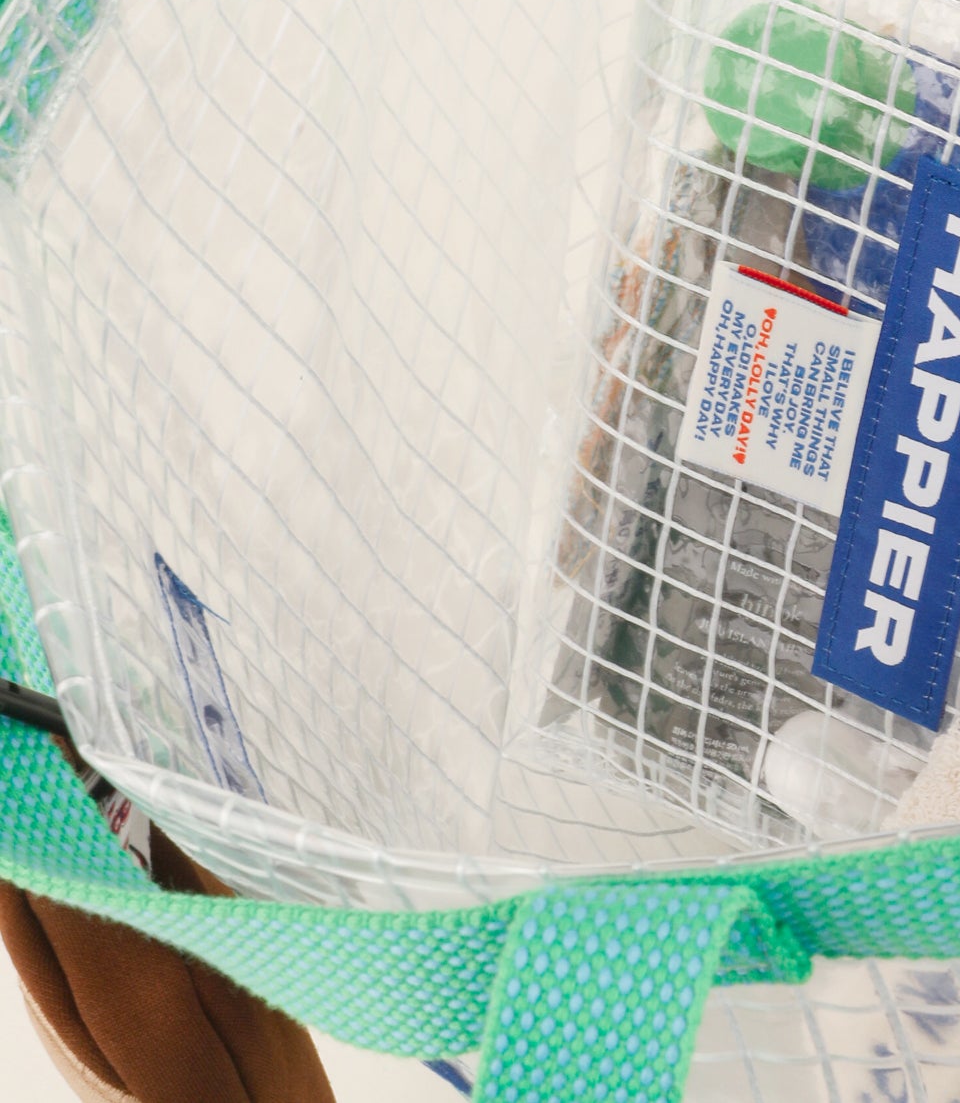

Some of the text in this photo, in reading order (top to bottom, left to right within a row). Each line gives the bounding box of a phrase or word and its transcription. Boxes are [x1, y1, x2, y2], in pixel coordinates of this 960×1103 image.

[704, 334, 726, 397] HAPPY
[709, 311, 746, 438] MY EVERY DAY
[745, 353, 765, 410] LOLLY
[758, 362, 778, 418] I LOVE
[765, 343, 798, 450] THAT'S WHY
[827, 358, 854, 432] BELIEVE
[694, 398, 712, 441] DAY!
[724, 372, 747, 437] MAKES
[782, 364, 806, 434] BIG JOY.
[789, 341, 826, 471] CAN BRING ME
[802, 344, 841, 477] SMALL THINGS
[735, 411, 754, 453] DAY!
[817, 436, 837, 482] THAT
[730, 561, 760, 580] Made
